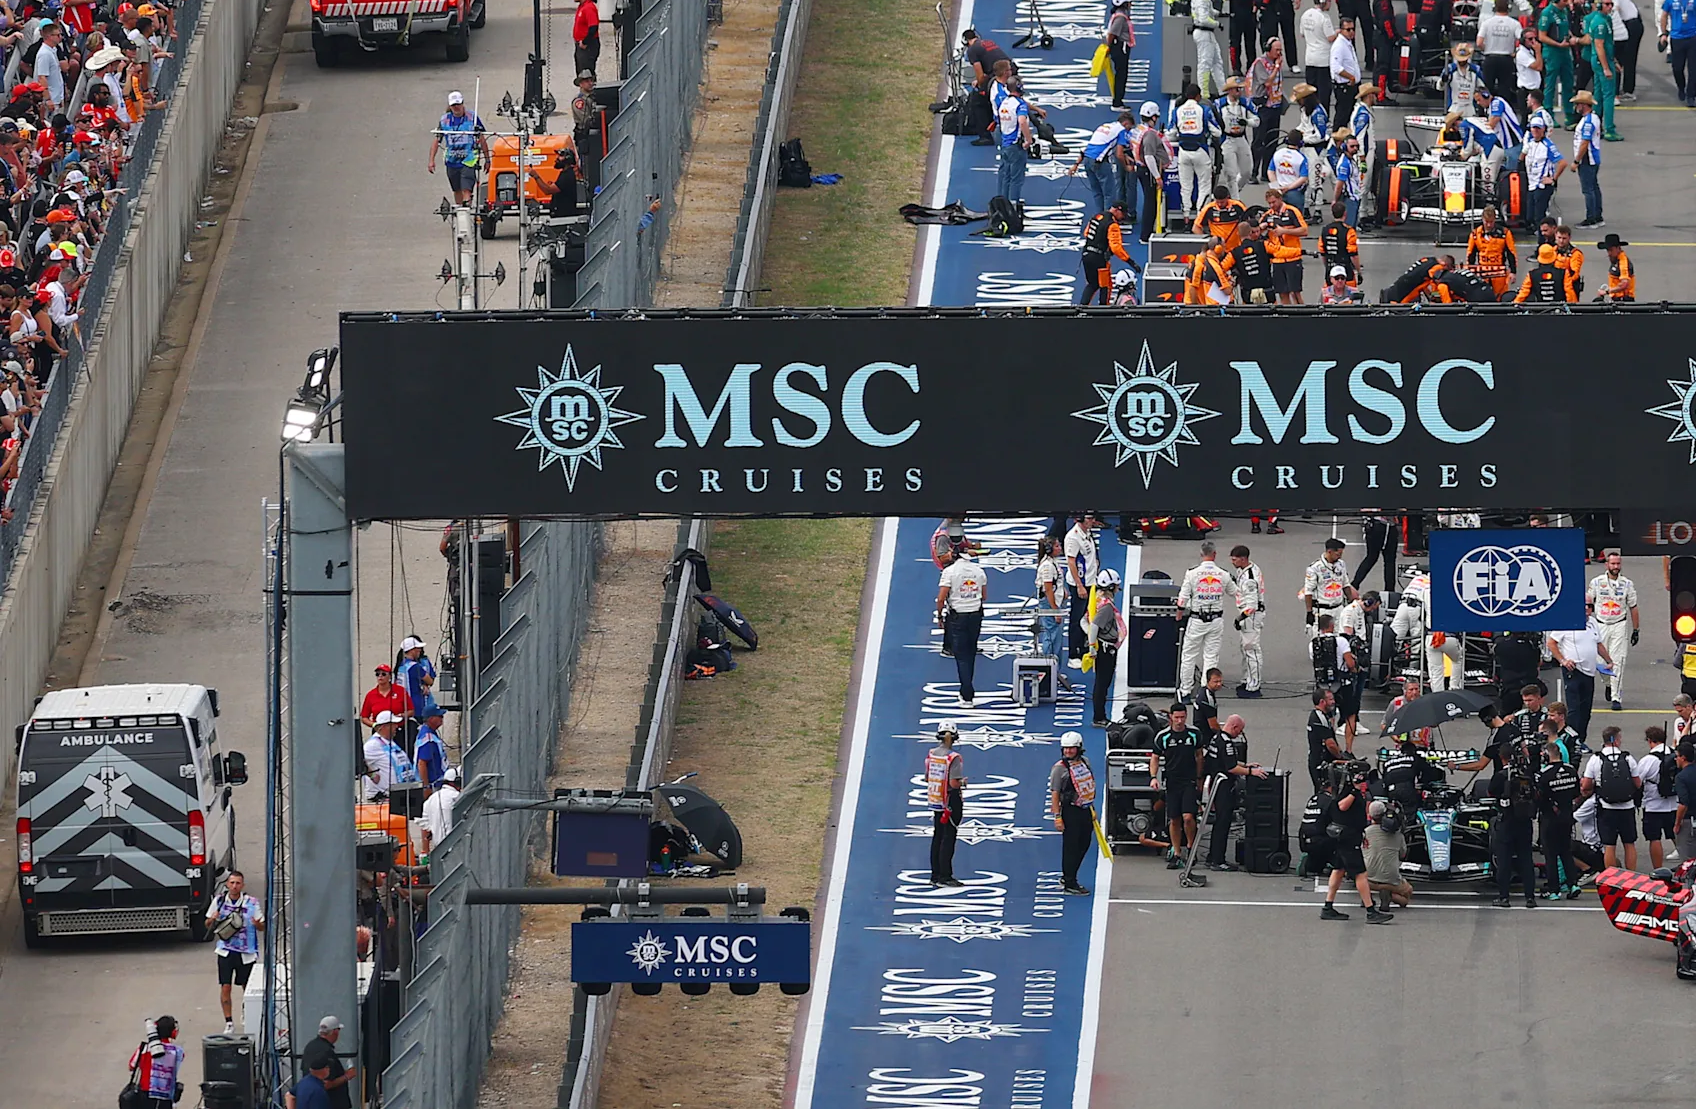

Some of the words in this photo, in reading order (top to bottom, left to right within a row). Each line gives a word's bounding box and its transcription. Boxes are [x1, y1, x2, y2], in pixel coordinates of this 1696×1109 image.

[1314, 163, 1322, 189] HUGO
[654, 362, 920, 447] MSC
[1230, 359, 1495, 444] MSC
[656, 468, 921, 492] CRUISES
[1232, 465, 1496, 489] CRUISES
[1210, 586, 1222, 594] Bull
[1464, 669, 1486, 677] VISA
[60, 733, 154, 747] AMBULANCE
[1125, 763, 1149, 772] 12
[1549, 777, 1577, 787] PETRONAS
[893, 870, 1009, 917] MSC
[1033, 870, 1065, 919] CRUISES
[1637, 915, 1679, 932] AMG
[674, 936, 757, 963] MSC
[674, 968, 758, 977] CRUISES
[880, 968, 997, 1017] MSC
[1022, 968, 1057, 1018] CRUISES
[1010, 1068, 1046, 1109] RUISES
